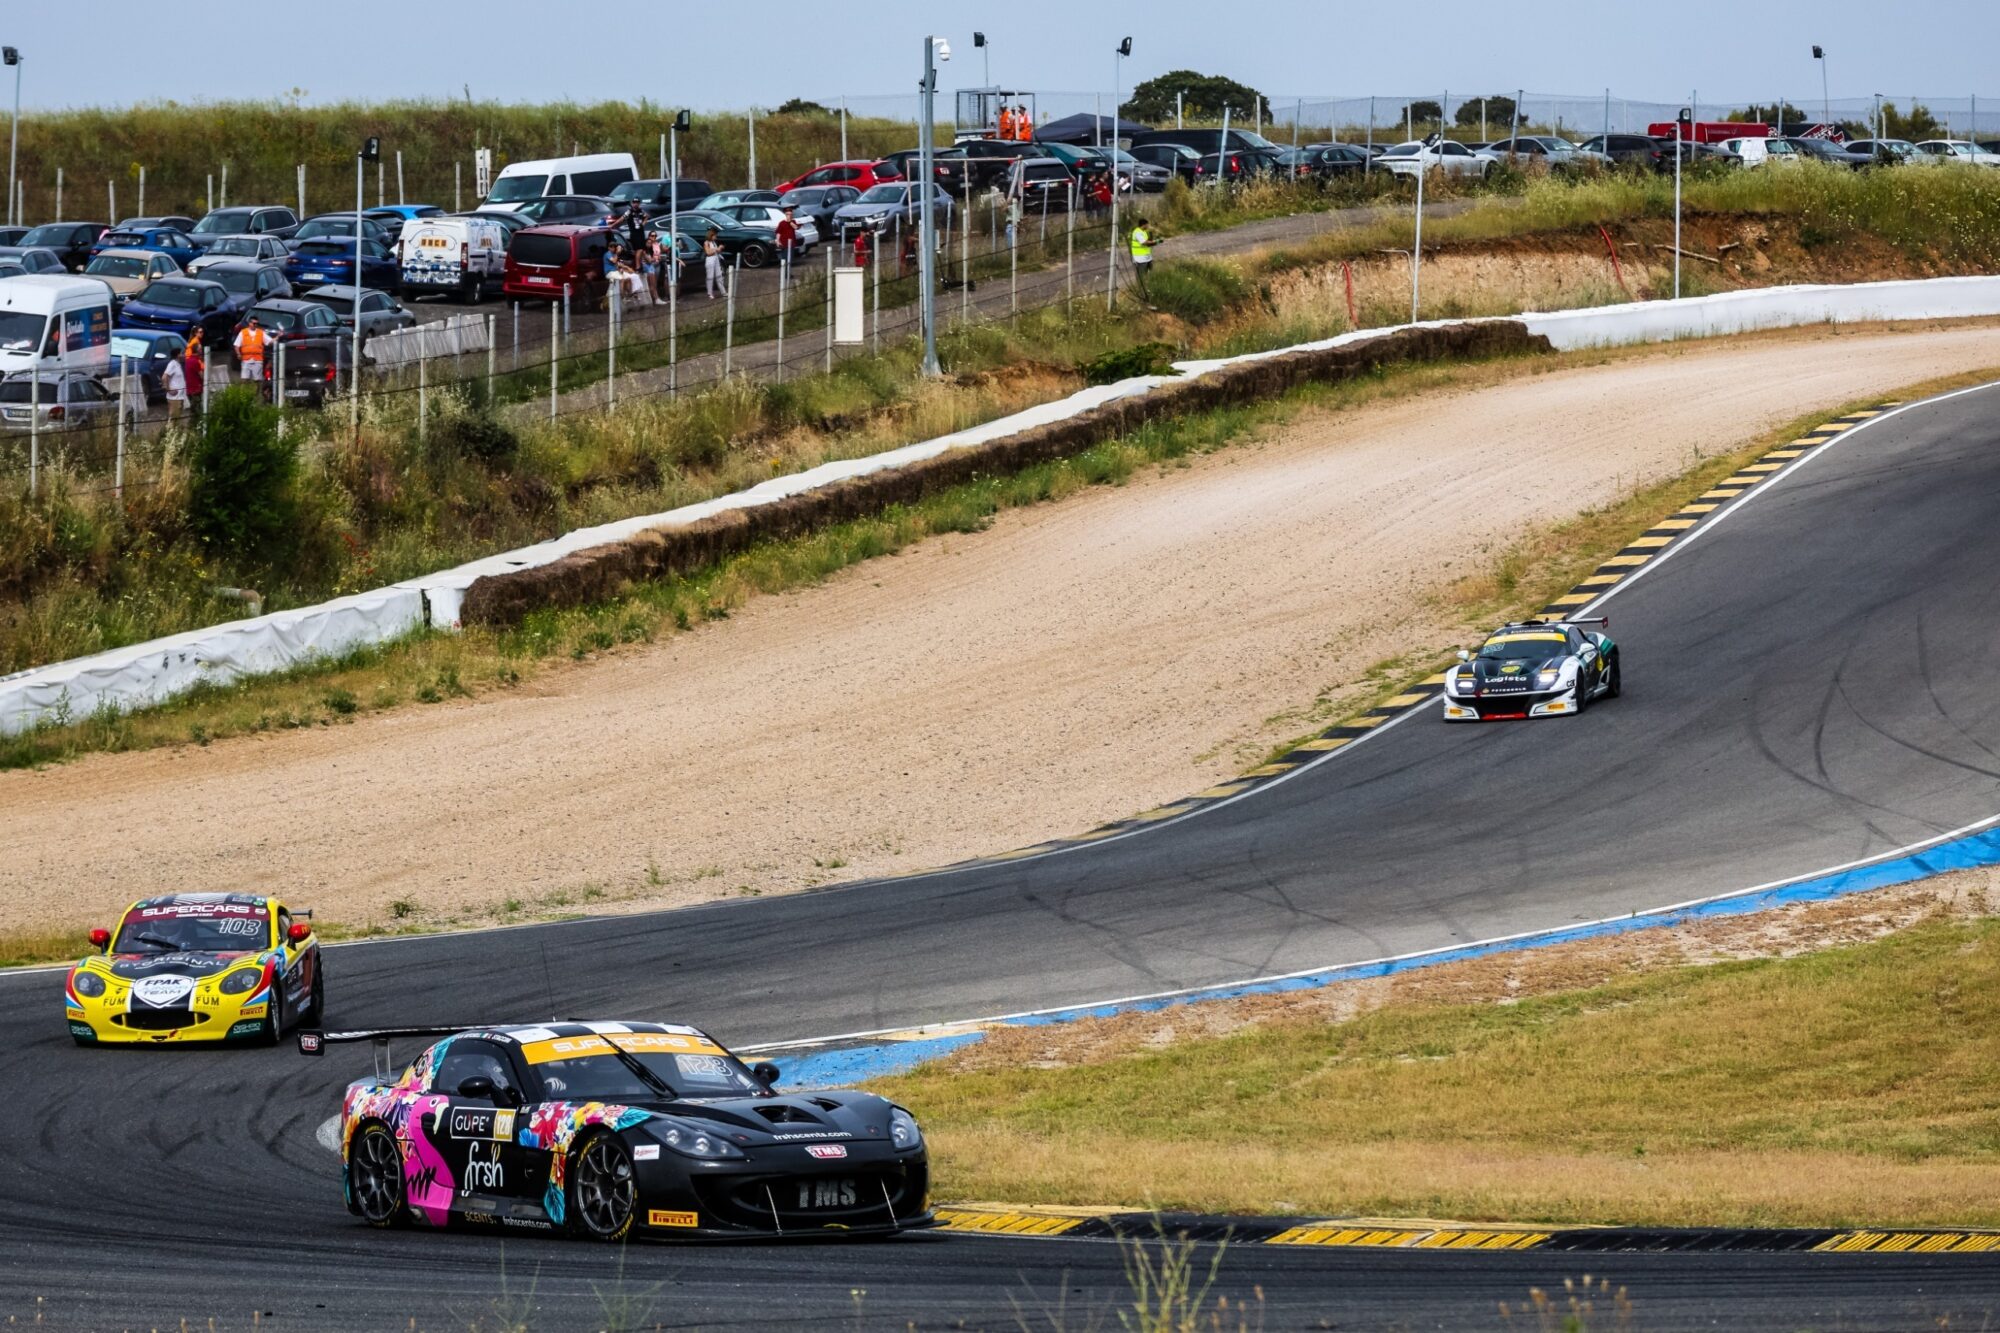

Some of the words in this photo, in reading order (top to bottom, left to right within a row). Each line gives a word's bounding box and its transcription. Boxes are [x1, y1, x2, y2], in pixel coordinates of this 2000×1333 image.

[142, 905, 249, 917] SUPERCARS
[218, 917, 261, 936] 103
[103, 997, 126, 1007] FUM
[195, 996, 220, 1006] FUM
[552, 1037, 690, 1053] SUPERCARS
[675, 1054, 733, 1077] 128
[773, 1132, 852, 1140] frshscents.com
[813, 1147, 841, 1156] TMS
[464, 1140, 504, 1190] frsh
[797, 1180, 857, 1208] TMS
[653, 1212, 694, 1225] PIRELLI
